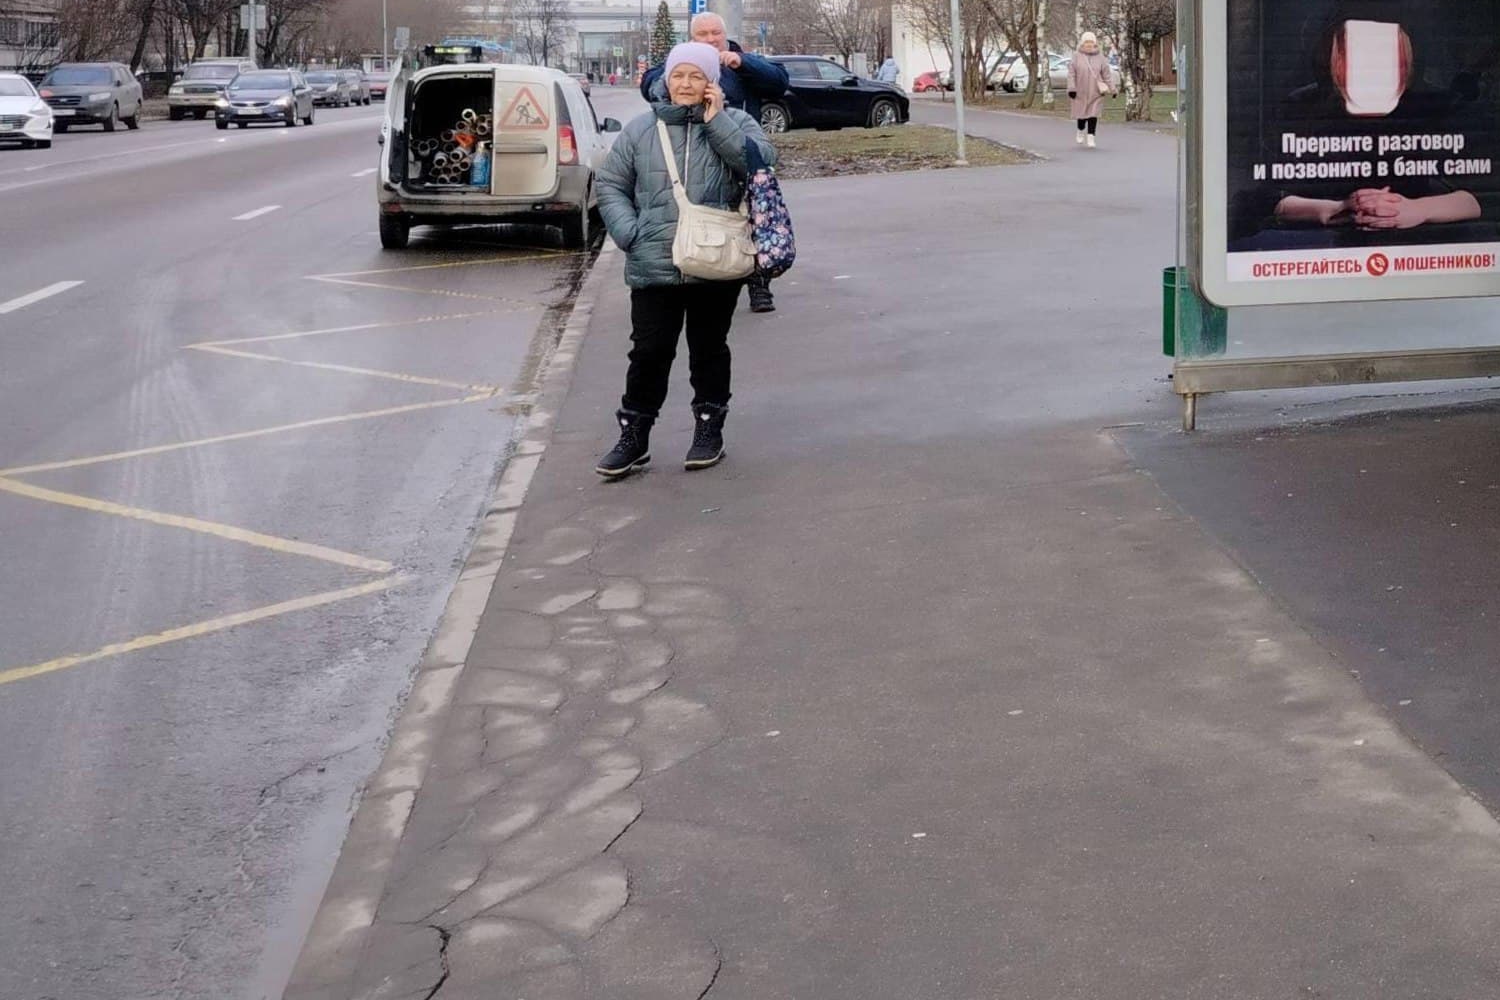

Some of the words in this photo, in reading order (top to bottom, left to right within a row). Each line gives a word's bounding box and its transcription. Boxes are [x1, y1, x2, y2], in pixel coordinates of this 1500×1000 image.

[1281, 132, 1373, 157] Прервите
[1378, 133, 1465, 155] разговор
[1253, 163, 1266, 180] и
[1271, 161, 1372, 180] позвоните
[1377, 160, 1388, 176] в
[1393, 156, 1439, 176] банк
[1443, 157, 1492, 175] сами
[1252, 257, 1362, 278] ОСТЕРЕГАЙТЕСЬ
[1393, 253, 1496, 272] МОШЕННИКОВ!
